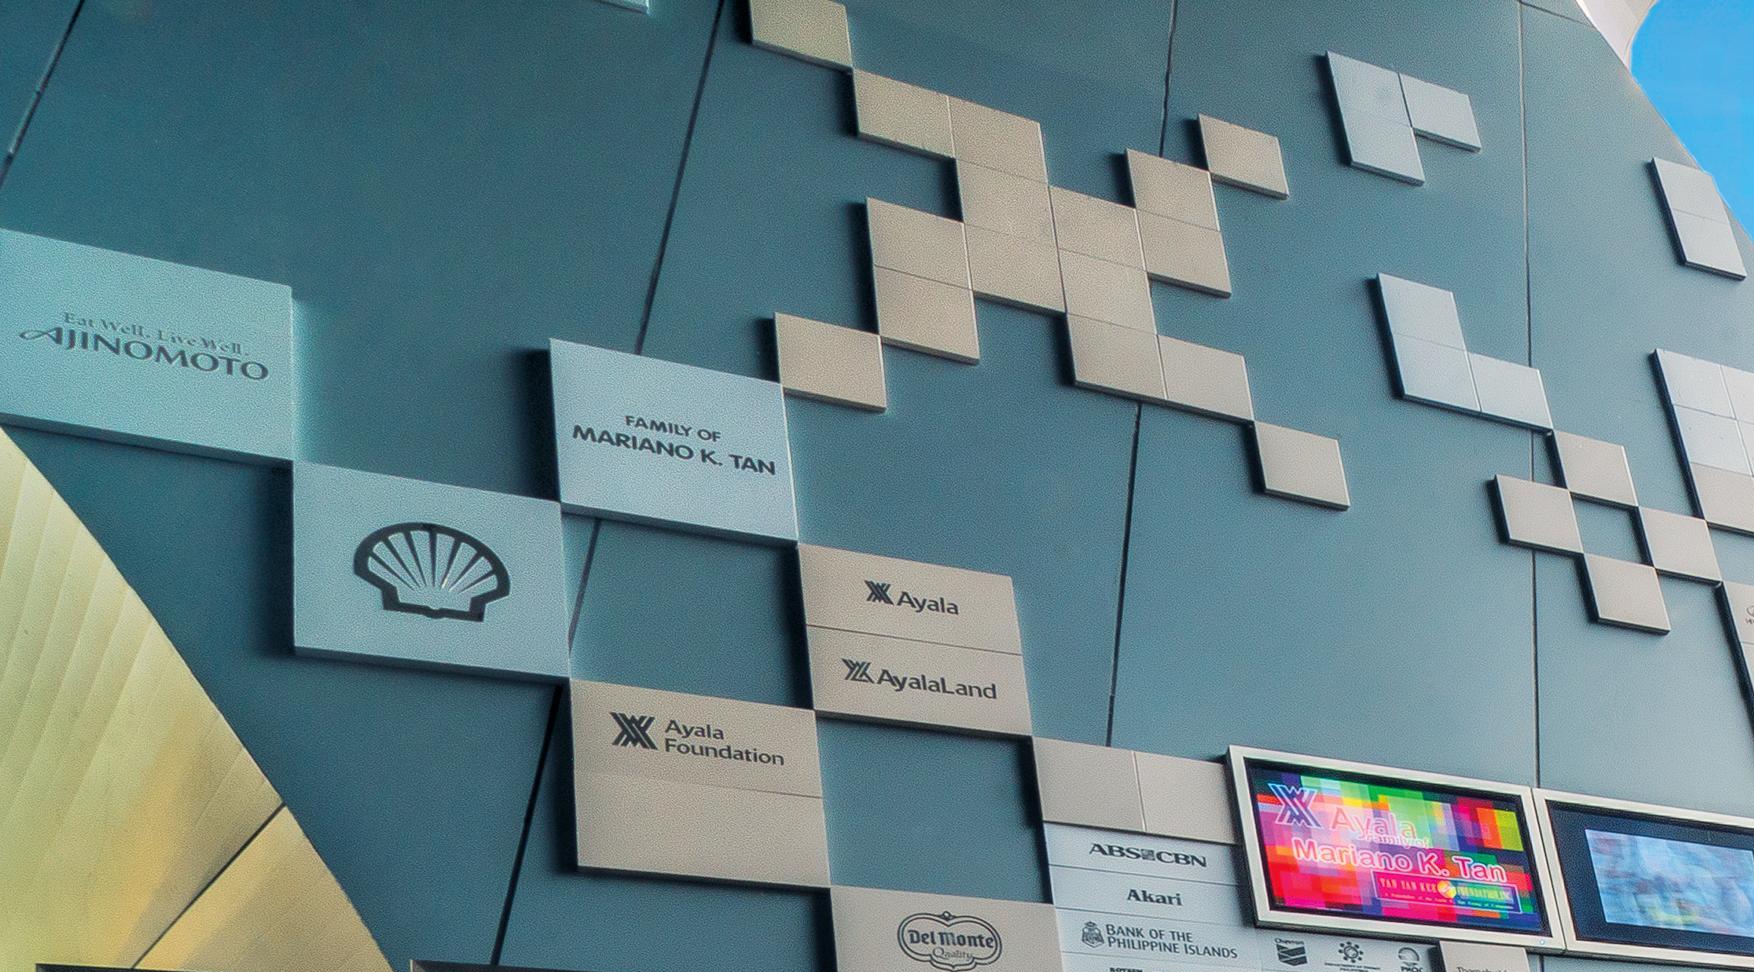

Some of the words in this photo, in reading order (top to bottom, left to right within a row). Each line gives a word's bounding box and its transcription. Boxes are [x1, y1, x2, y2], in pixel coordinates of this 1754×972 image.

[63, 311, 97, 328] Eat
[157, 329, 195, 347] Live
[19, 326, 268, 380] AJINOMOTO
[625, 415, 692, 437] FAMILY
[697, 428, 722, 442] OF
[573, 424, 694, 460] MARIANO
[699, 448, 723, 466] K.
[729, 453, 776, 475] TAN
[897, 591, 959, 615] Ayala
[877, 668, 997, 699] AyalaLand
[665, 720, 724, 740] Ayala
[665, 738, 785, 766] Foundation
[1330, 806, 1417, 839] Ayala
[1291, 836, 1413, 873] Mariano
[1417, 853, 1449, 876] K.
[1453, 856, 1508, 883] Tan
[1127, 888, 1183, 907] Akari
[906, 929, 935, 945] Del
[938, 930, 995, 949] Monte
[1150, 928, 1165, 940] OF
[1170, 930, 1193, 943] THE
